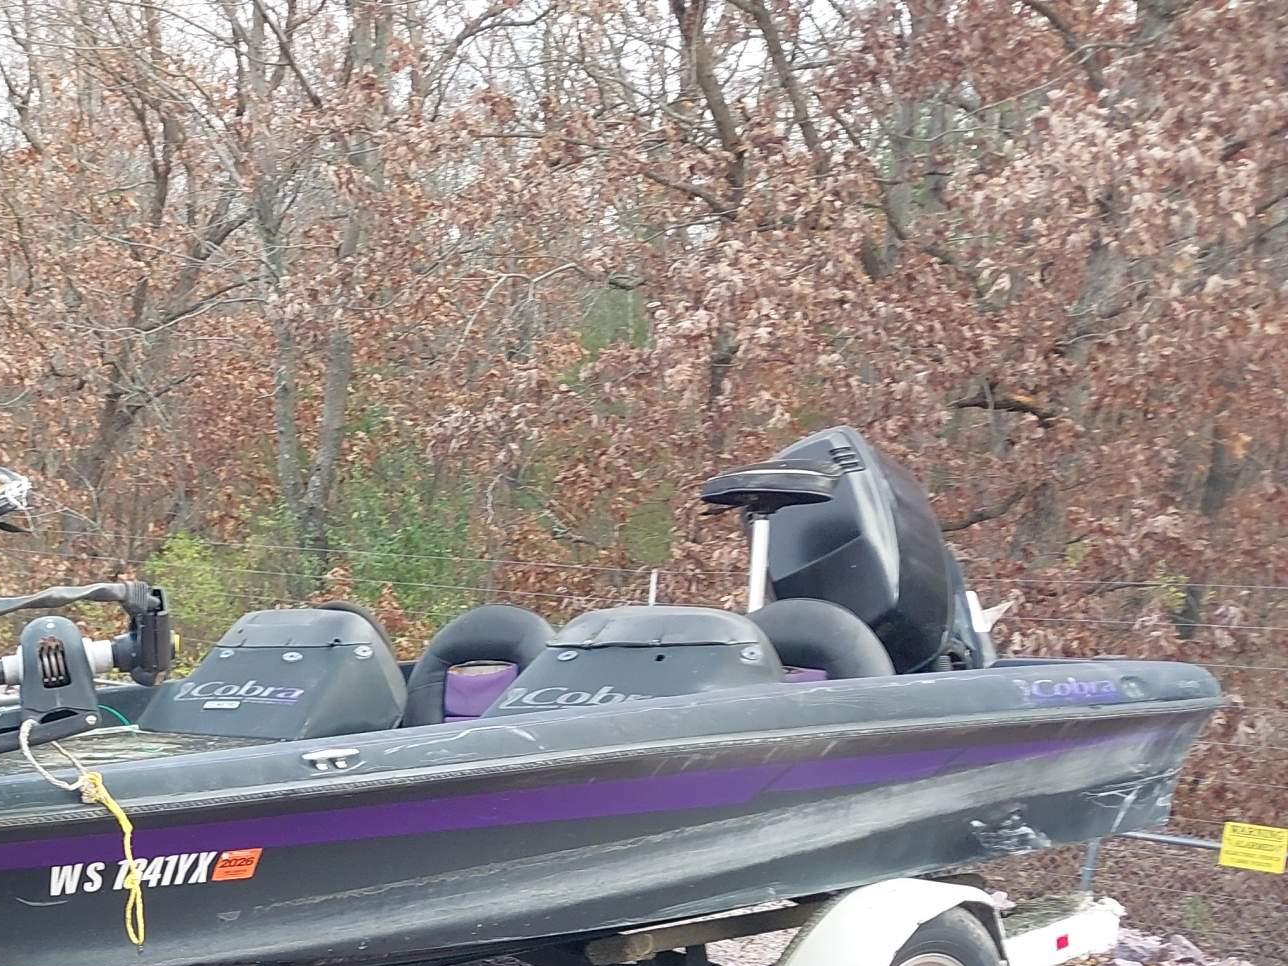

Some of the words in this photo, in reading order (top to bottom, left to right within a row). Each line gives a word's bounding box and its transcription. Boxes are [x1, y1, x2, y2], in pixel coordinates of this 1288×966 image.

[189, 679, 305, 699] Cobra
[1030, 677, 1117, 698] Cobra
[218, 856, 255, 869] 2026
[49, 861, 106, 897] WS
